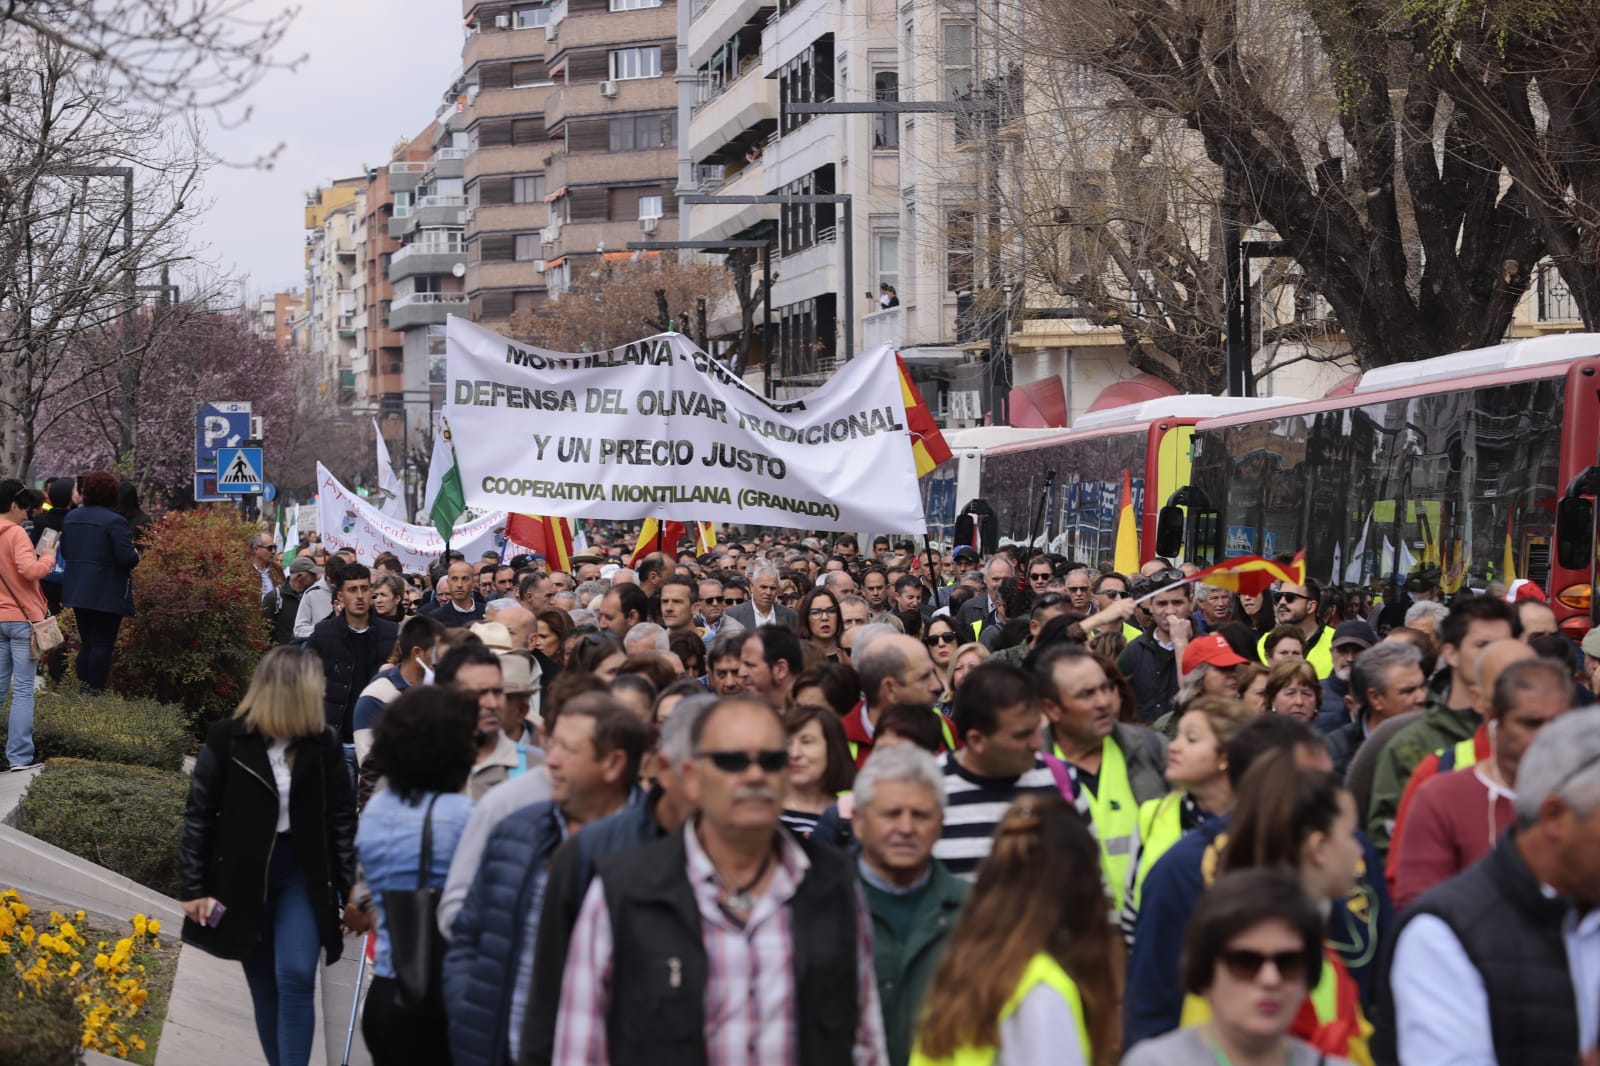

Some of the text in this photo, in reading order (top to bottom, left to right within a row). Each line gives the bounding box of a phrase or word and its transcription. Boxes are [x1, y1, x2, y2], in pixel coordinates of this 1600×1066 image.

[506, 340, 674, 371] MONTILLANA
[205, 415, 230, 448] P
[454, 379, 903, 446] DEFENSA DEL OLIVAR TRADICIONAL
[533, 434, 787, 480] Y UN PRECIO JUSTO
[481, 476, 840, 521] COOPERATIVA MONTILLANA (GRANADA)
